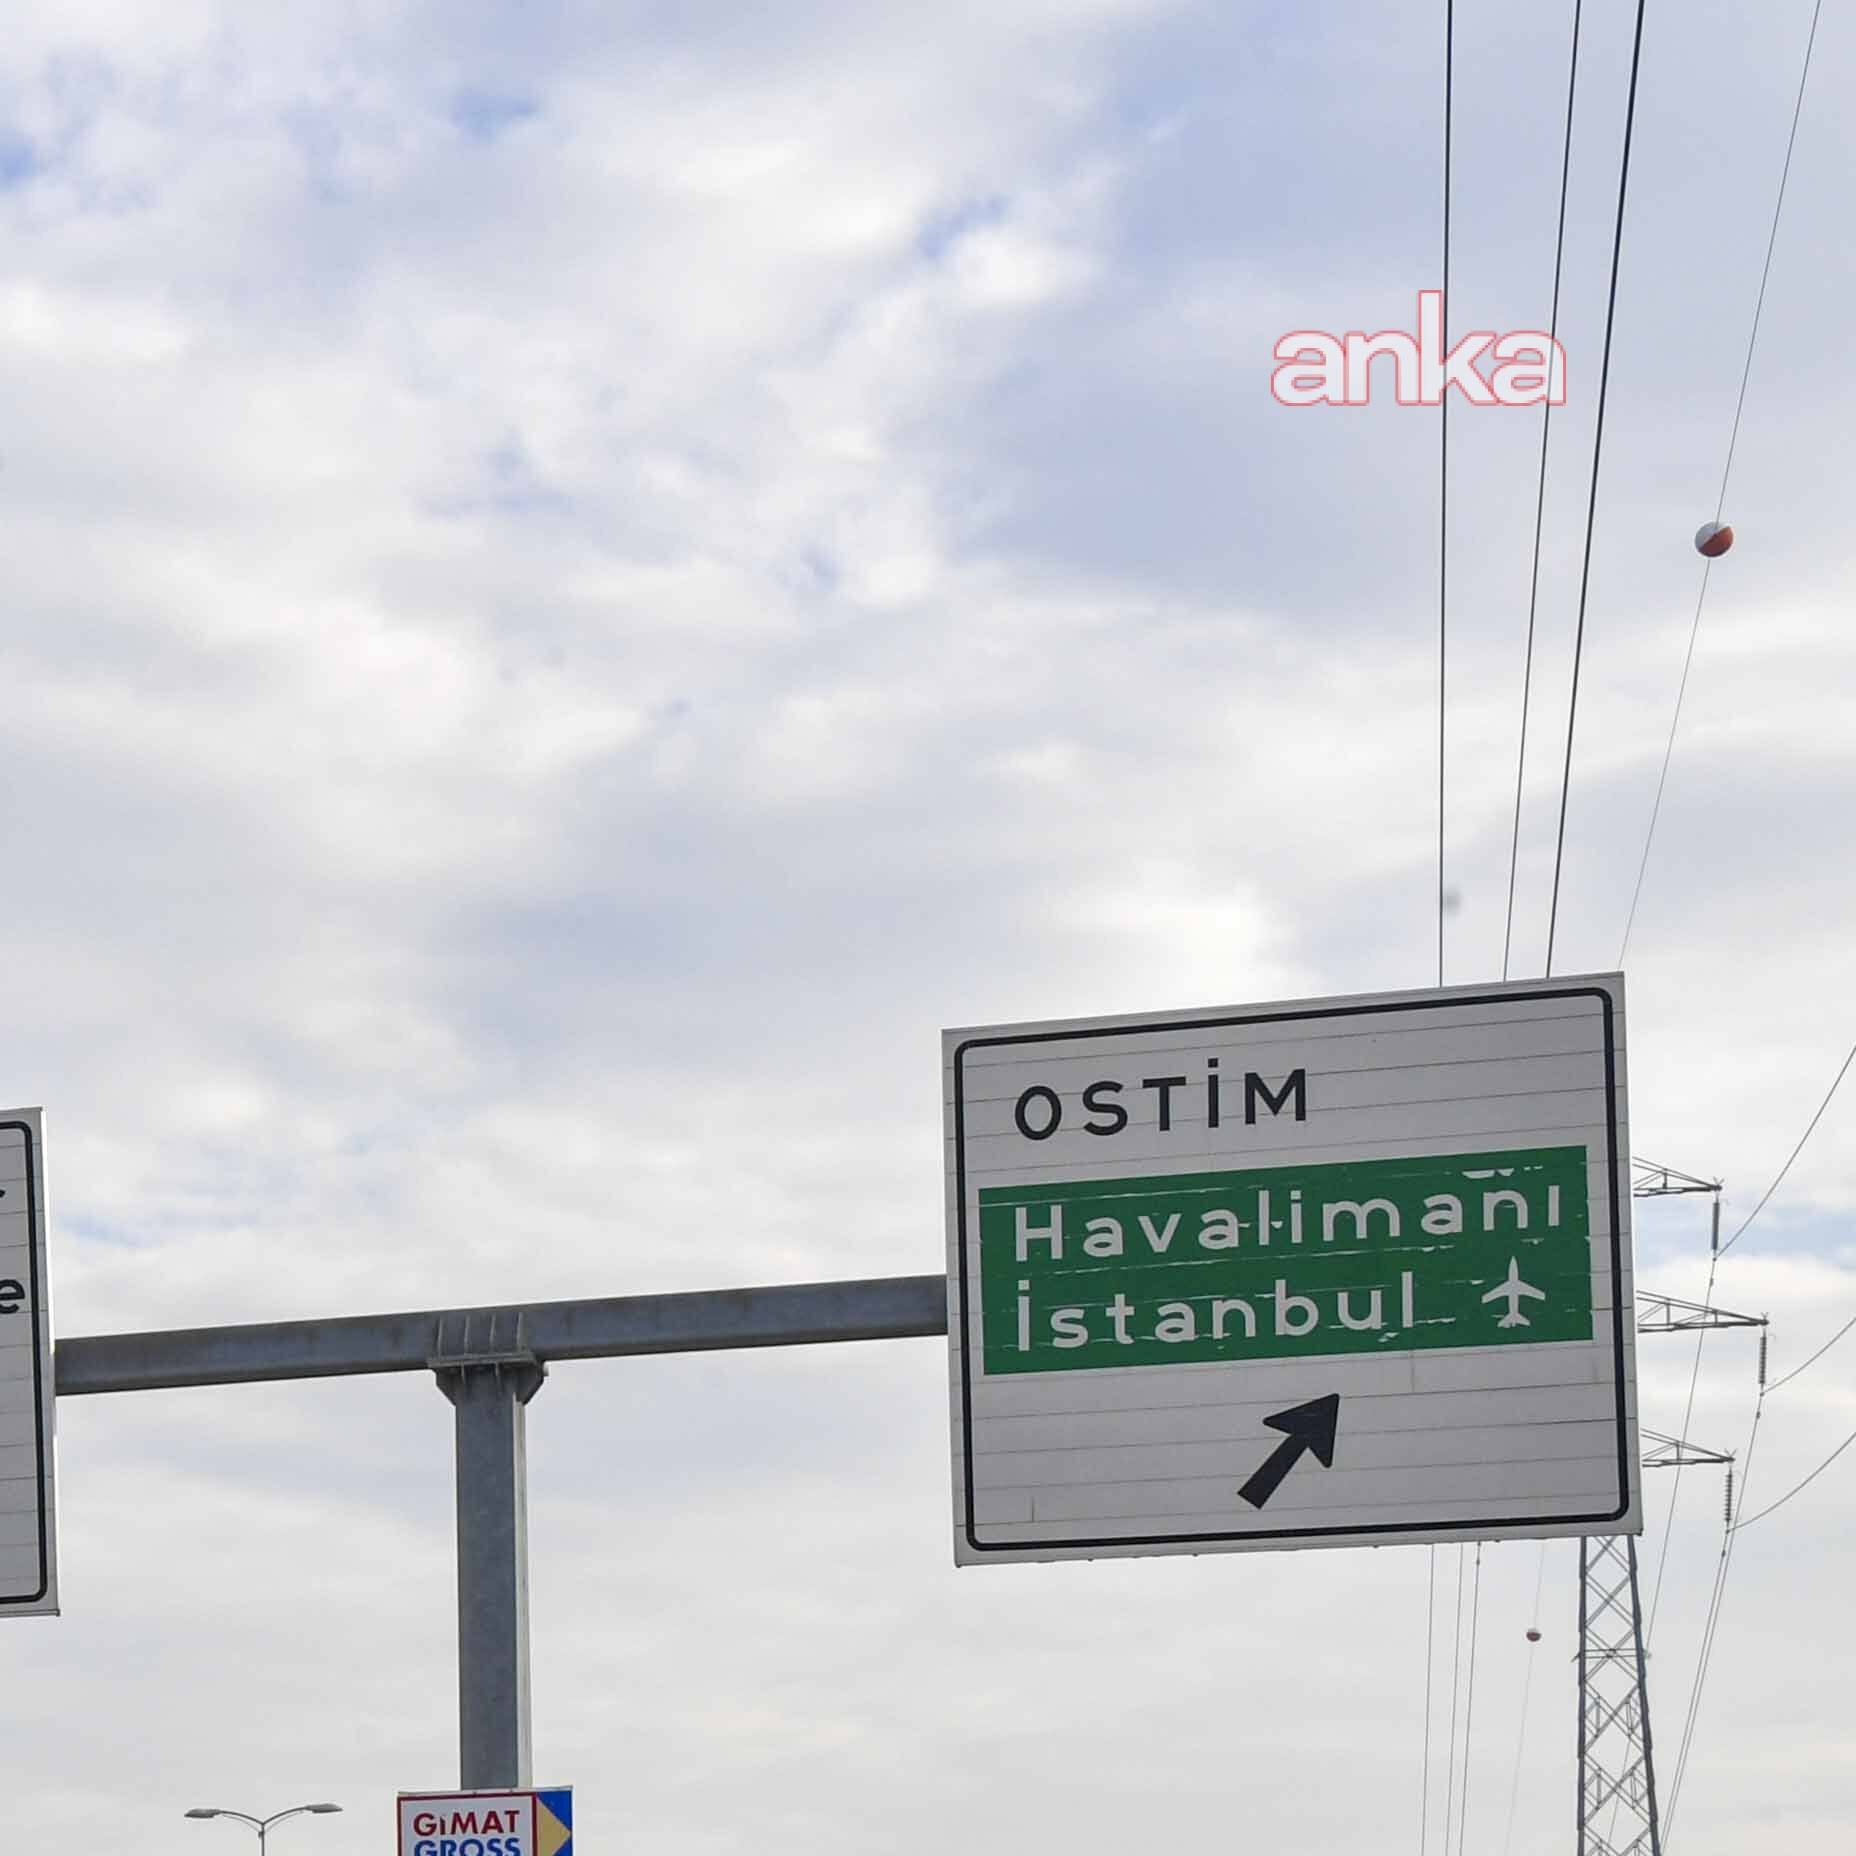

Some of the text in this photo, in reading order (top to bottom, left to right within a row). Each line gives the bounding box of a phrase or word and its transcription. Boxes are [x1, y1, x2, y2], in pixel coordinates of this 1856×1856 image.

[1015, 1058, 1307, 1141] OSTİM
[1015, 1185, 1560, 1262] Havalimanı
[1018, 1272, 1414, 1352] İstanbul
